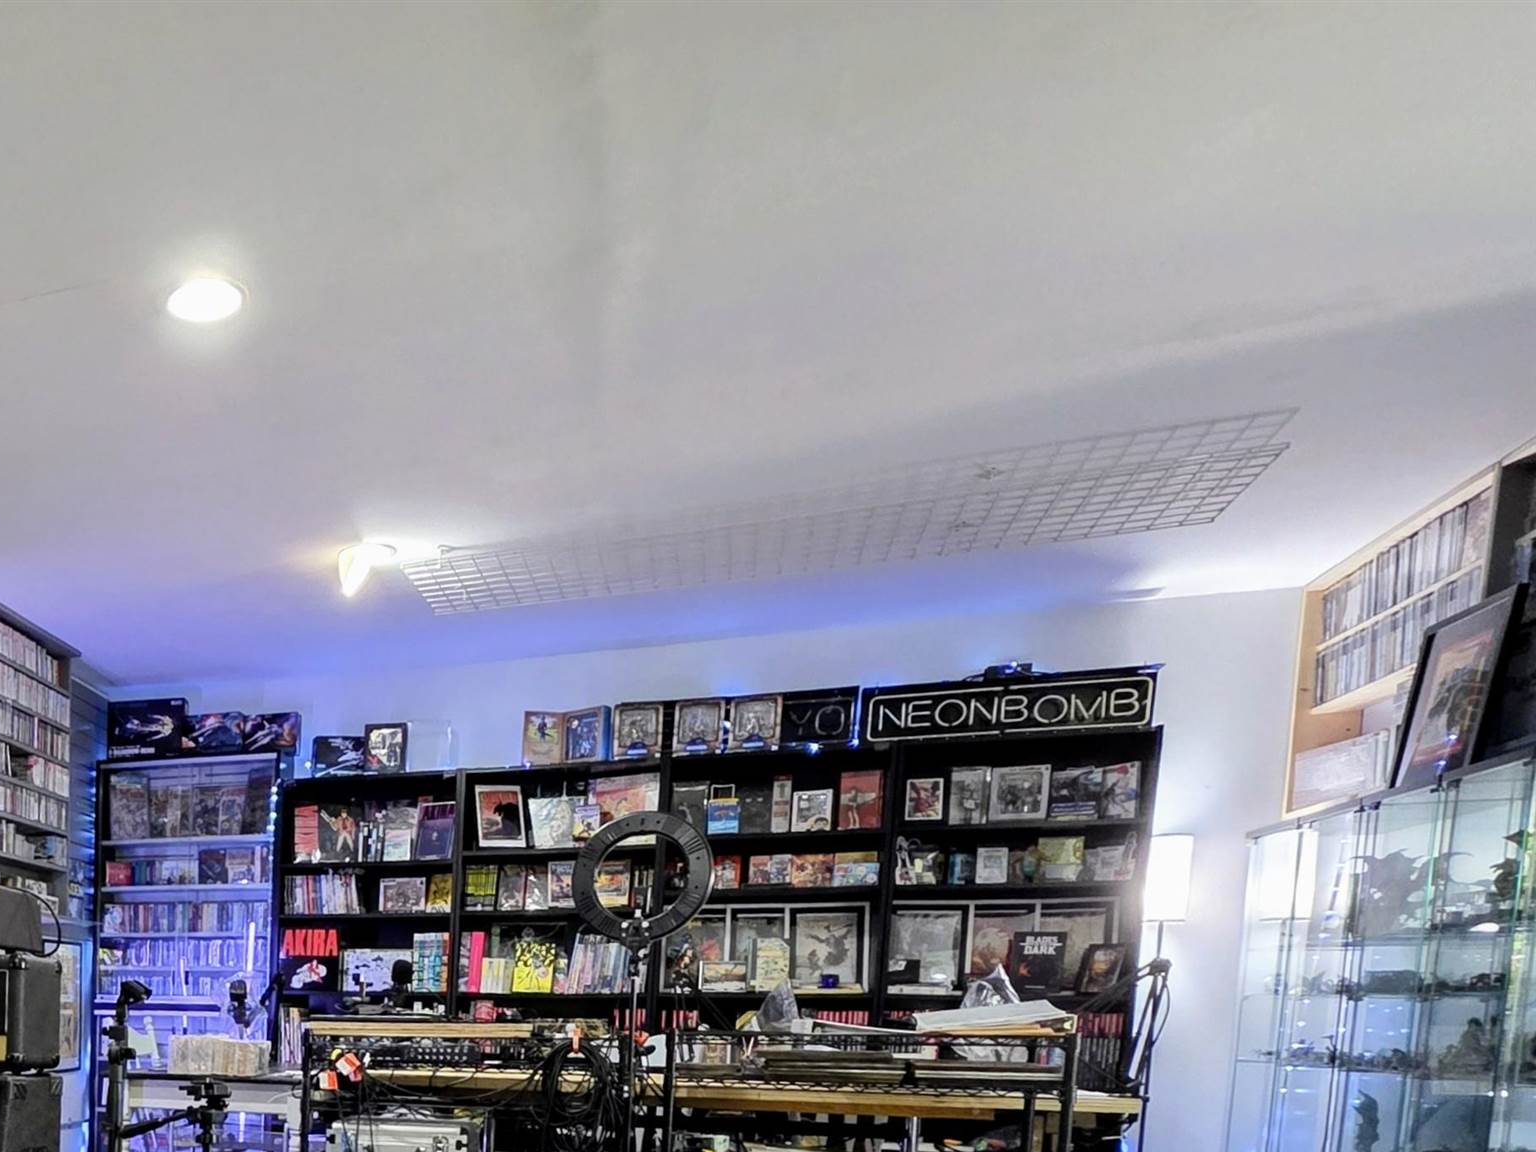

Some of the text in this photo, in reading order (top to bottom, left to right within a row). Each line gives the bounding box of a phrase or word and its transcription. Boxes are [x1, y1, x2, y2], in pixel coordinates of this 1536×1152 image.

[877, 687, 1140, 732] NEONBOMB
[282, 928, 339, 957] AKIRA
[1023, 945, 1057, 955] DARK
